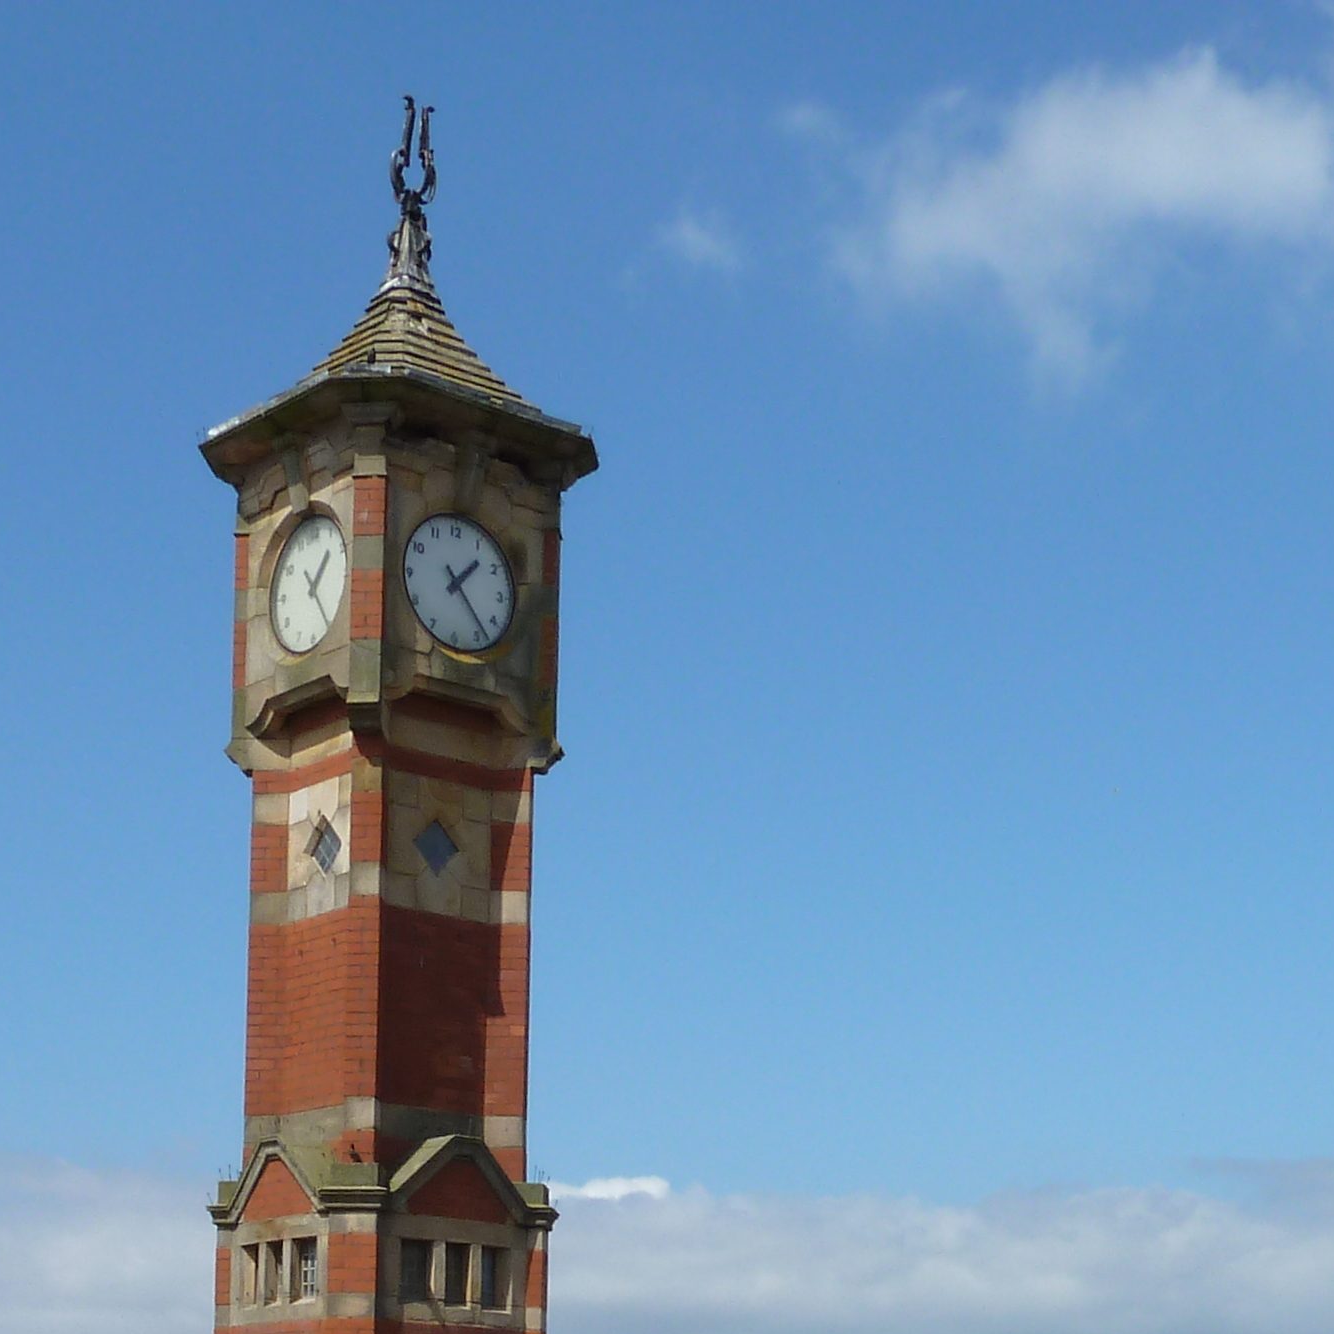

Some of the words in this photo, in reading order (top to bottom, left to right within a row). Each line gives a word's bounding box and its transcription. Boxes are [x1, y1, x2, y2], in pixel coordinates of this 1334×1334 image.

[431, 527, 440, 539] 11
[450, 525, 462, 539] 12
[413, 541, 425, 554] 10
[475, 540, 480, 551] 1
[407, 567, 413, 578] 9
[490, 563, 498, 575] 2
[412, 594, 419, 606] 8
[496, 591, 503, 603] 3
[429, 617, 436, 629] 7
[489, 615, 497, 626] 4
[473, 630, 480, 642] 5
